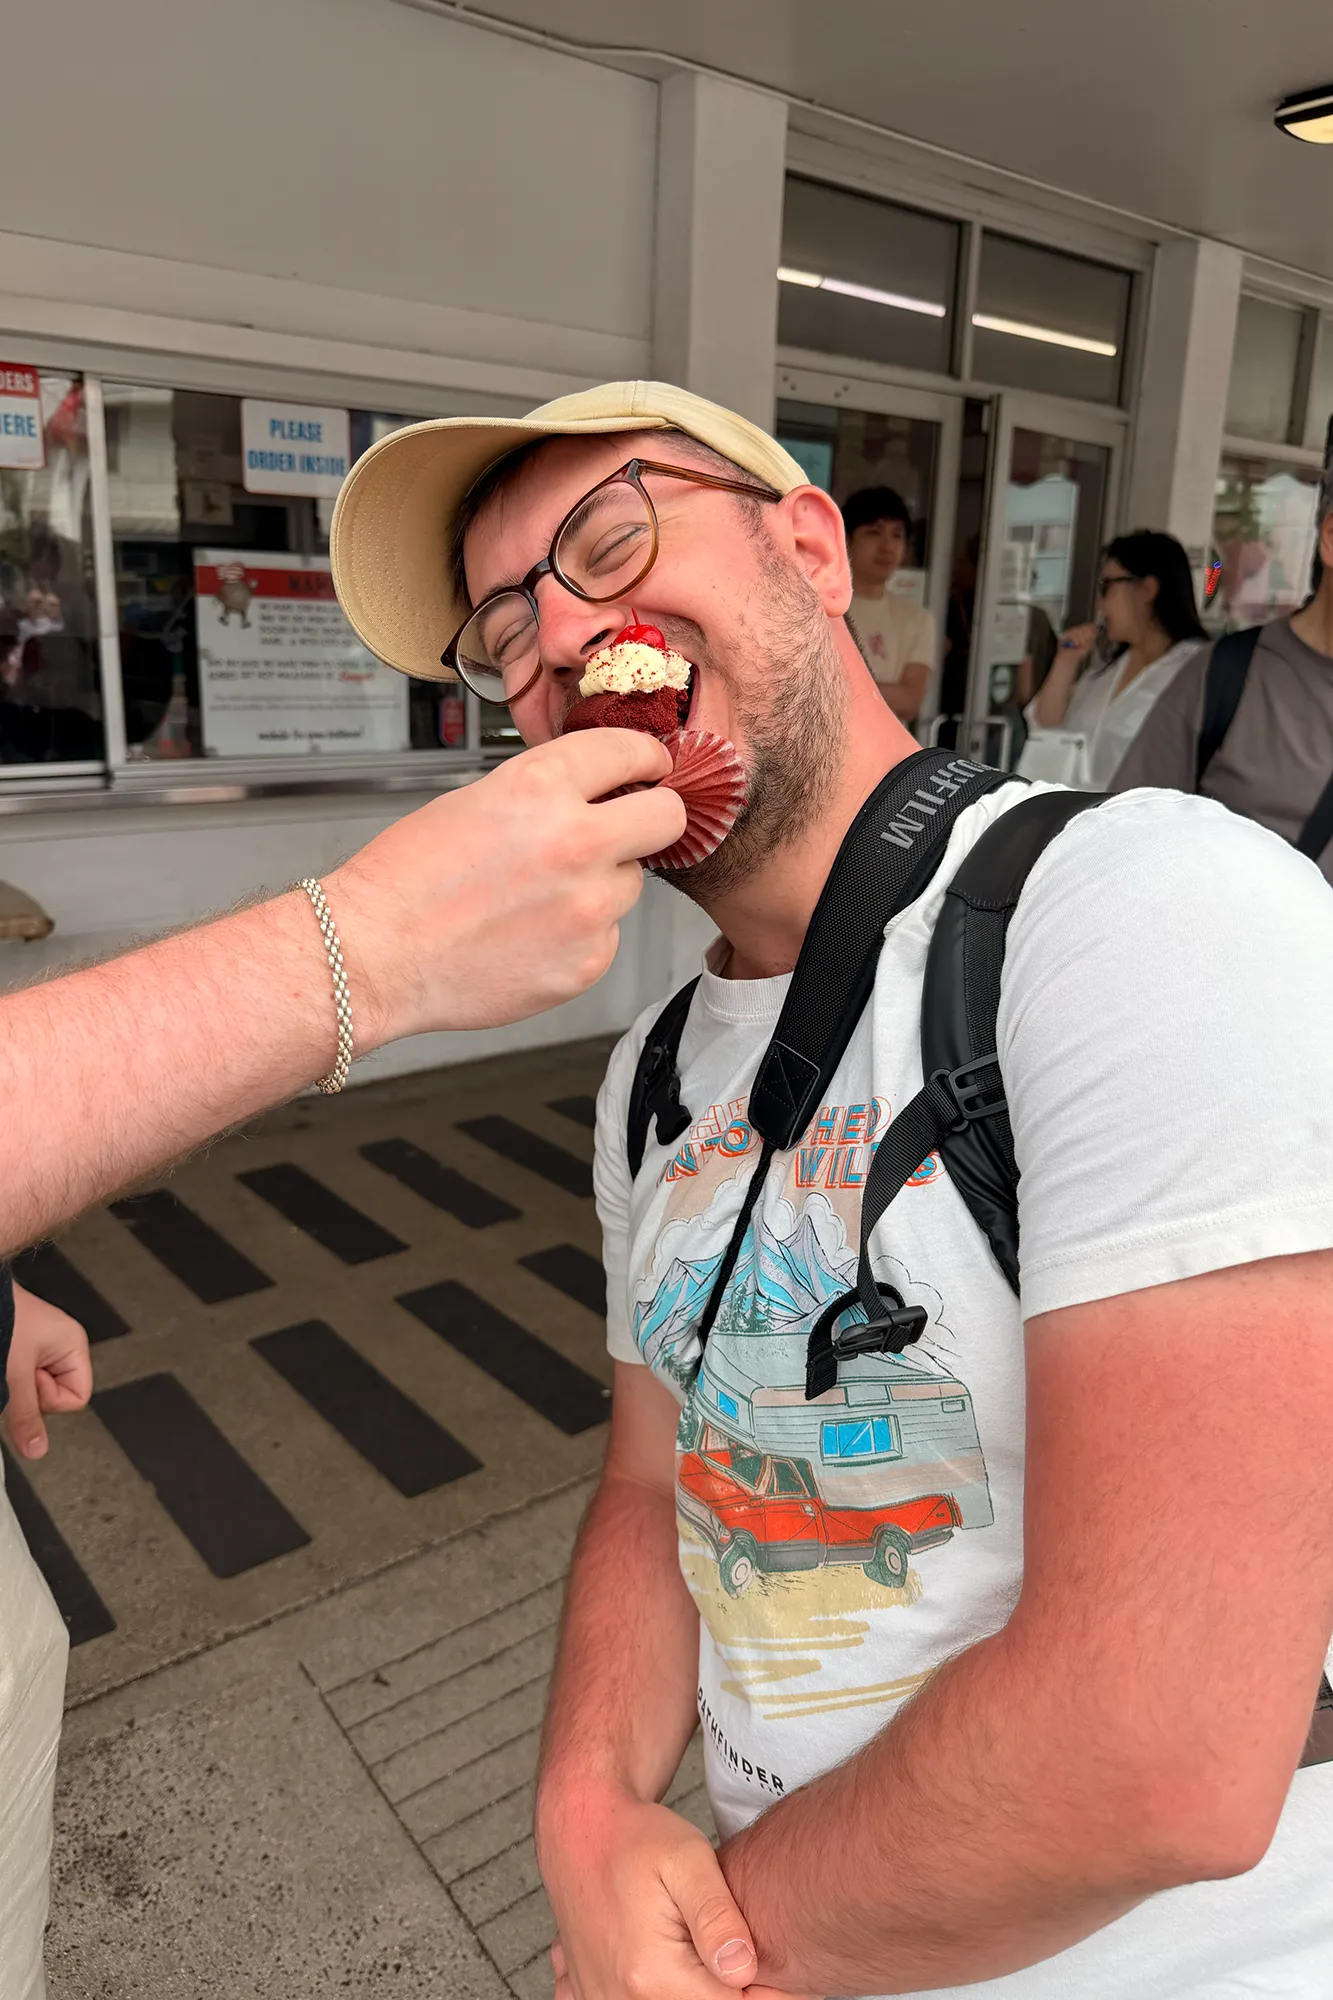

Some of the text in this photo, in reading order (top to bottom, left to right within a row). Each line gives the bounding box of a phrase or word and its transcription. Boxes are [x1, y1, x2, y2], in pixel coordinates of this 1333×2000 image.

[0, 411, 37, 438] ERE
[269, 417, 324, 444] PLEASE
[246, 450, 346, 478] ORDER INSIDE
